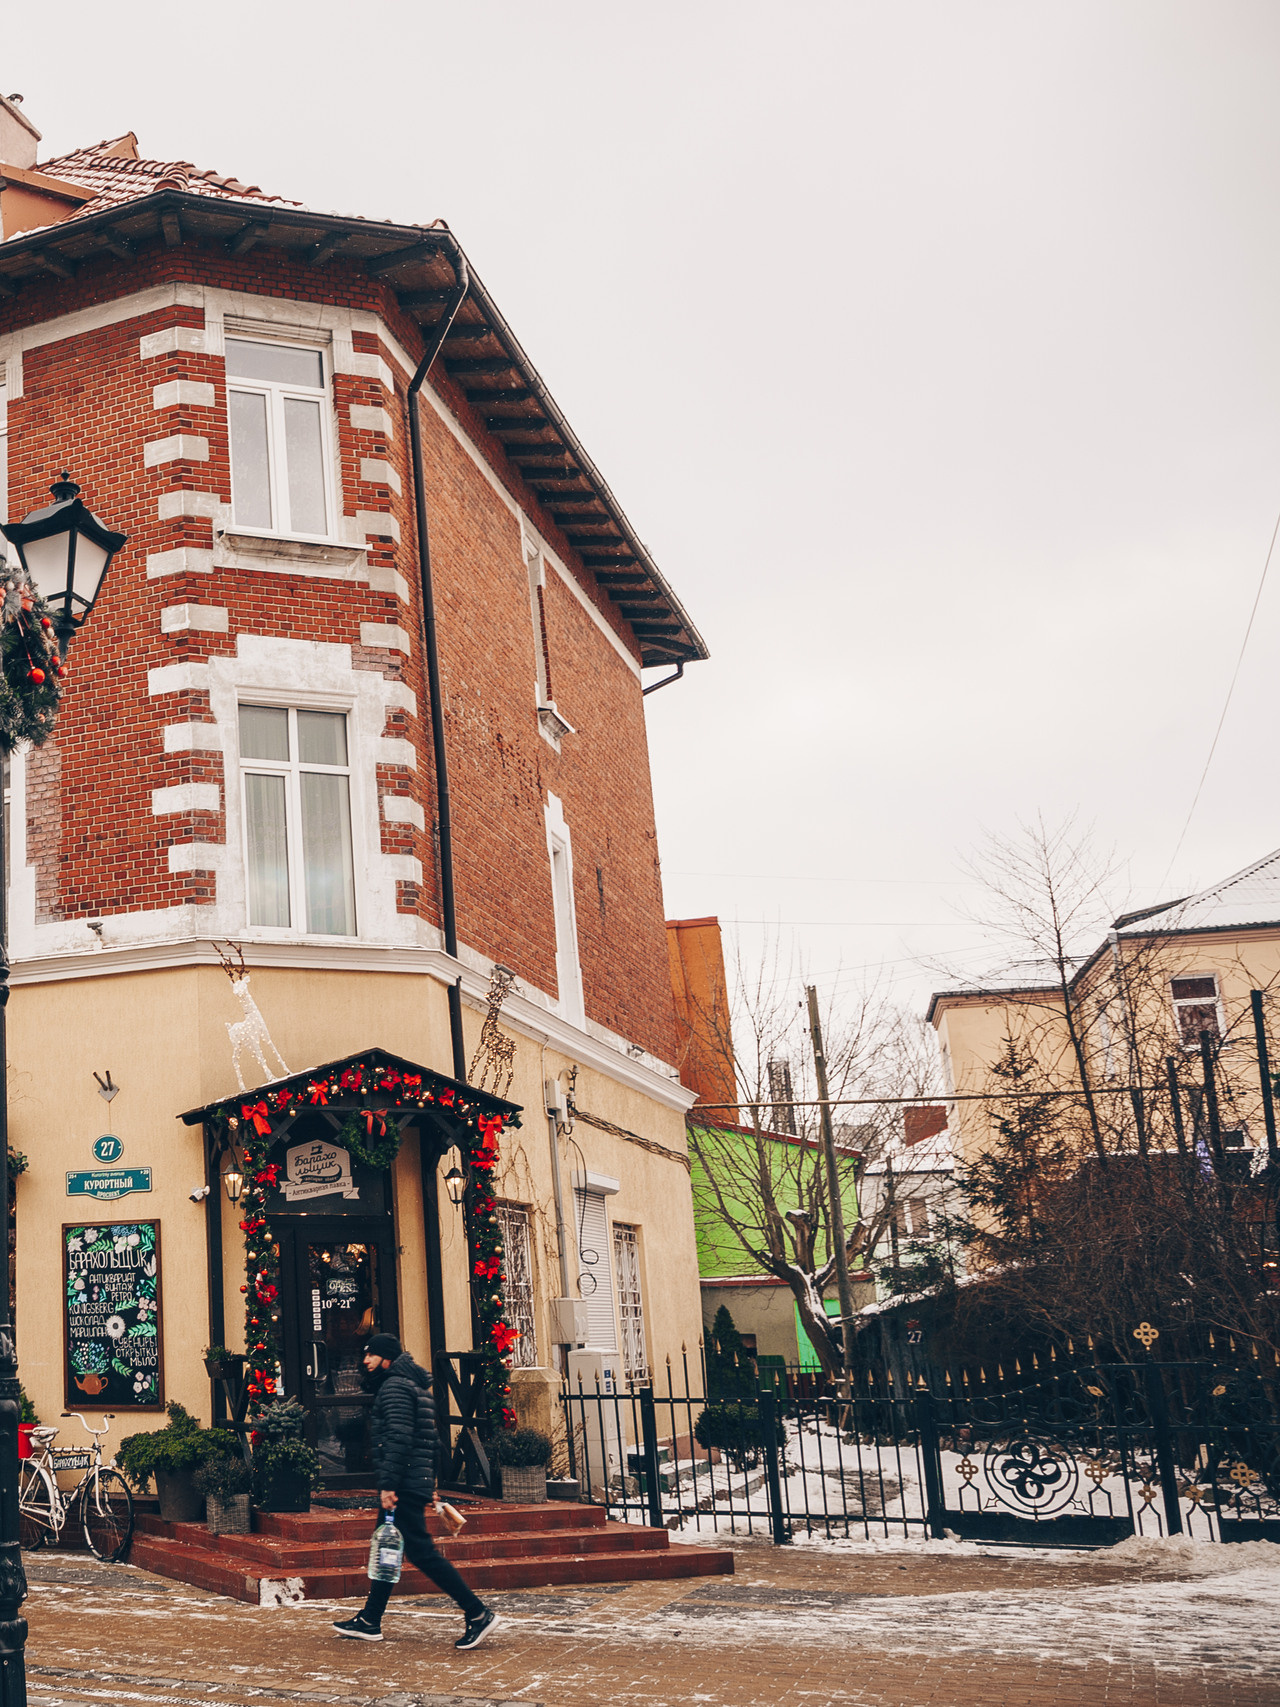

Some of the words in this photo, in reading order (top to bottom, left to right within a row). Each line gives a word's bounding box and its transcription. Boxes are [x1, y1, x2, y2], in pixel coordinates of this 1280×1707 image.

[100, 1141, 115, 1157] 27
[294, 1151, 337, 1168] Барахо
[295, 1160, 337, 1176] льщик
[84, 1176, 133, 1190] КУРОРТНЫЙ
[96, 1190, 120, 1198] ПРОСПЕКТ
[69, 1249, 147, 1270] БАРАХОЛЬЩИК
[88, 1272, 136, 1284] АНТИКВАРИАТ
[104, 1283, 134, 1293] ВИНТАЖ
[111, 1291, 133, 1301] РЕТРО
[69, 1315, 108, 1326] ШОКОЛАД
[69, 1326, 108, 1338] МАРЦИПАН
[907, 1330, 922, 1344] 27
[112, 1336, 157, 1349] СУВЕНИРЫ
[115, 1347, 158, 1358] ОТКРЫТКИ
[129, 1356, 157, 1367] МЫЛО
